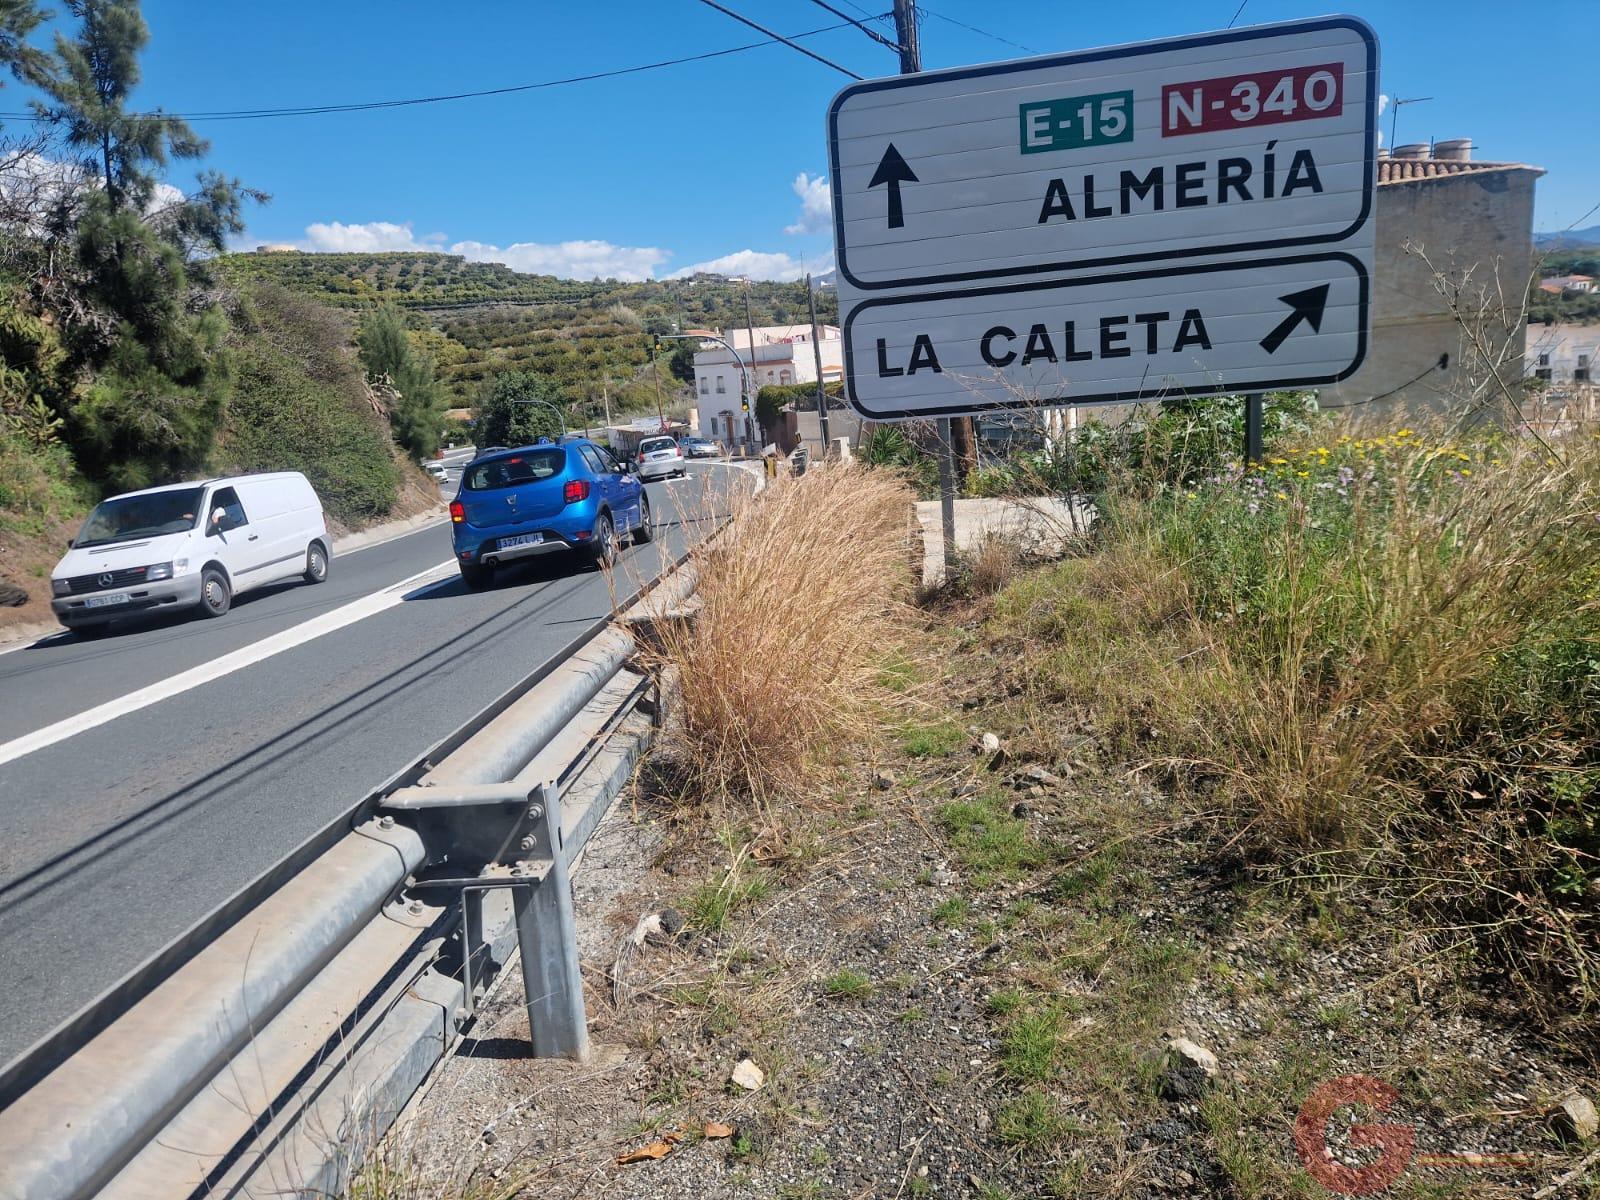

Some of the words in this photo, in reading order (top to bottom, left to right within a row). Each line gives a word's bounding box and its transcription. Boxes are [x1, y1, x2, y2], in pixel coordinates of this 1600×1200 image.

[1026, 97, 1127, 148] E-15
[1168, 70, 1338, 130] N-340
[1038, 139, 1323, 224] ALMERÍA
[877, 334, 943, 378] LA
[980, 308, 1213, 368] CALETA
